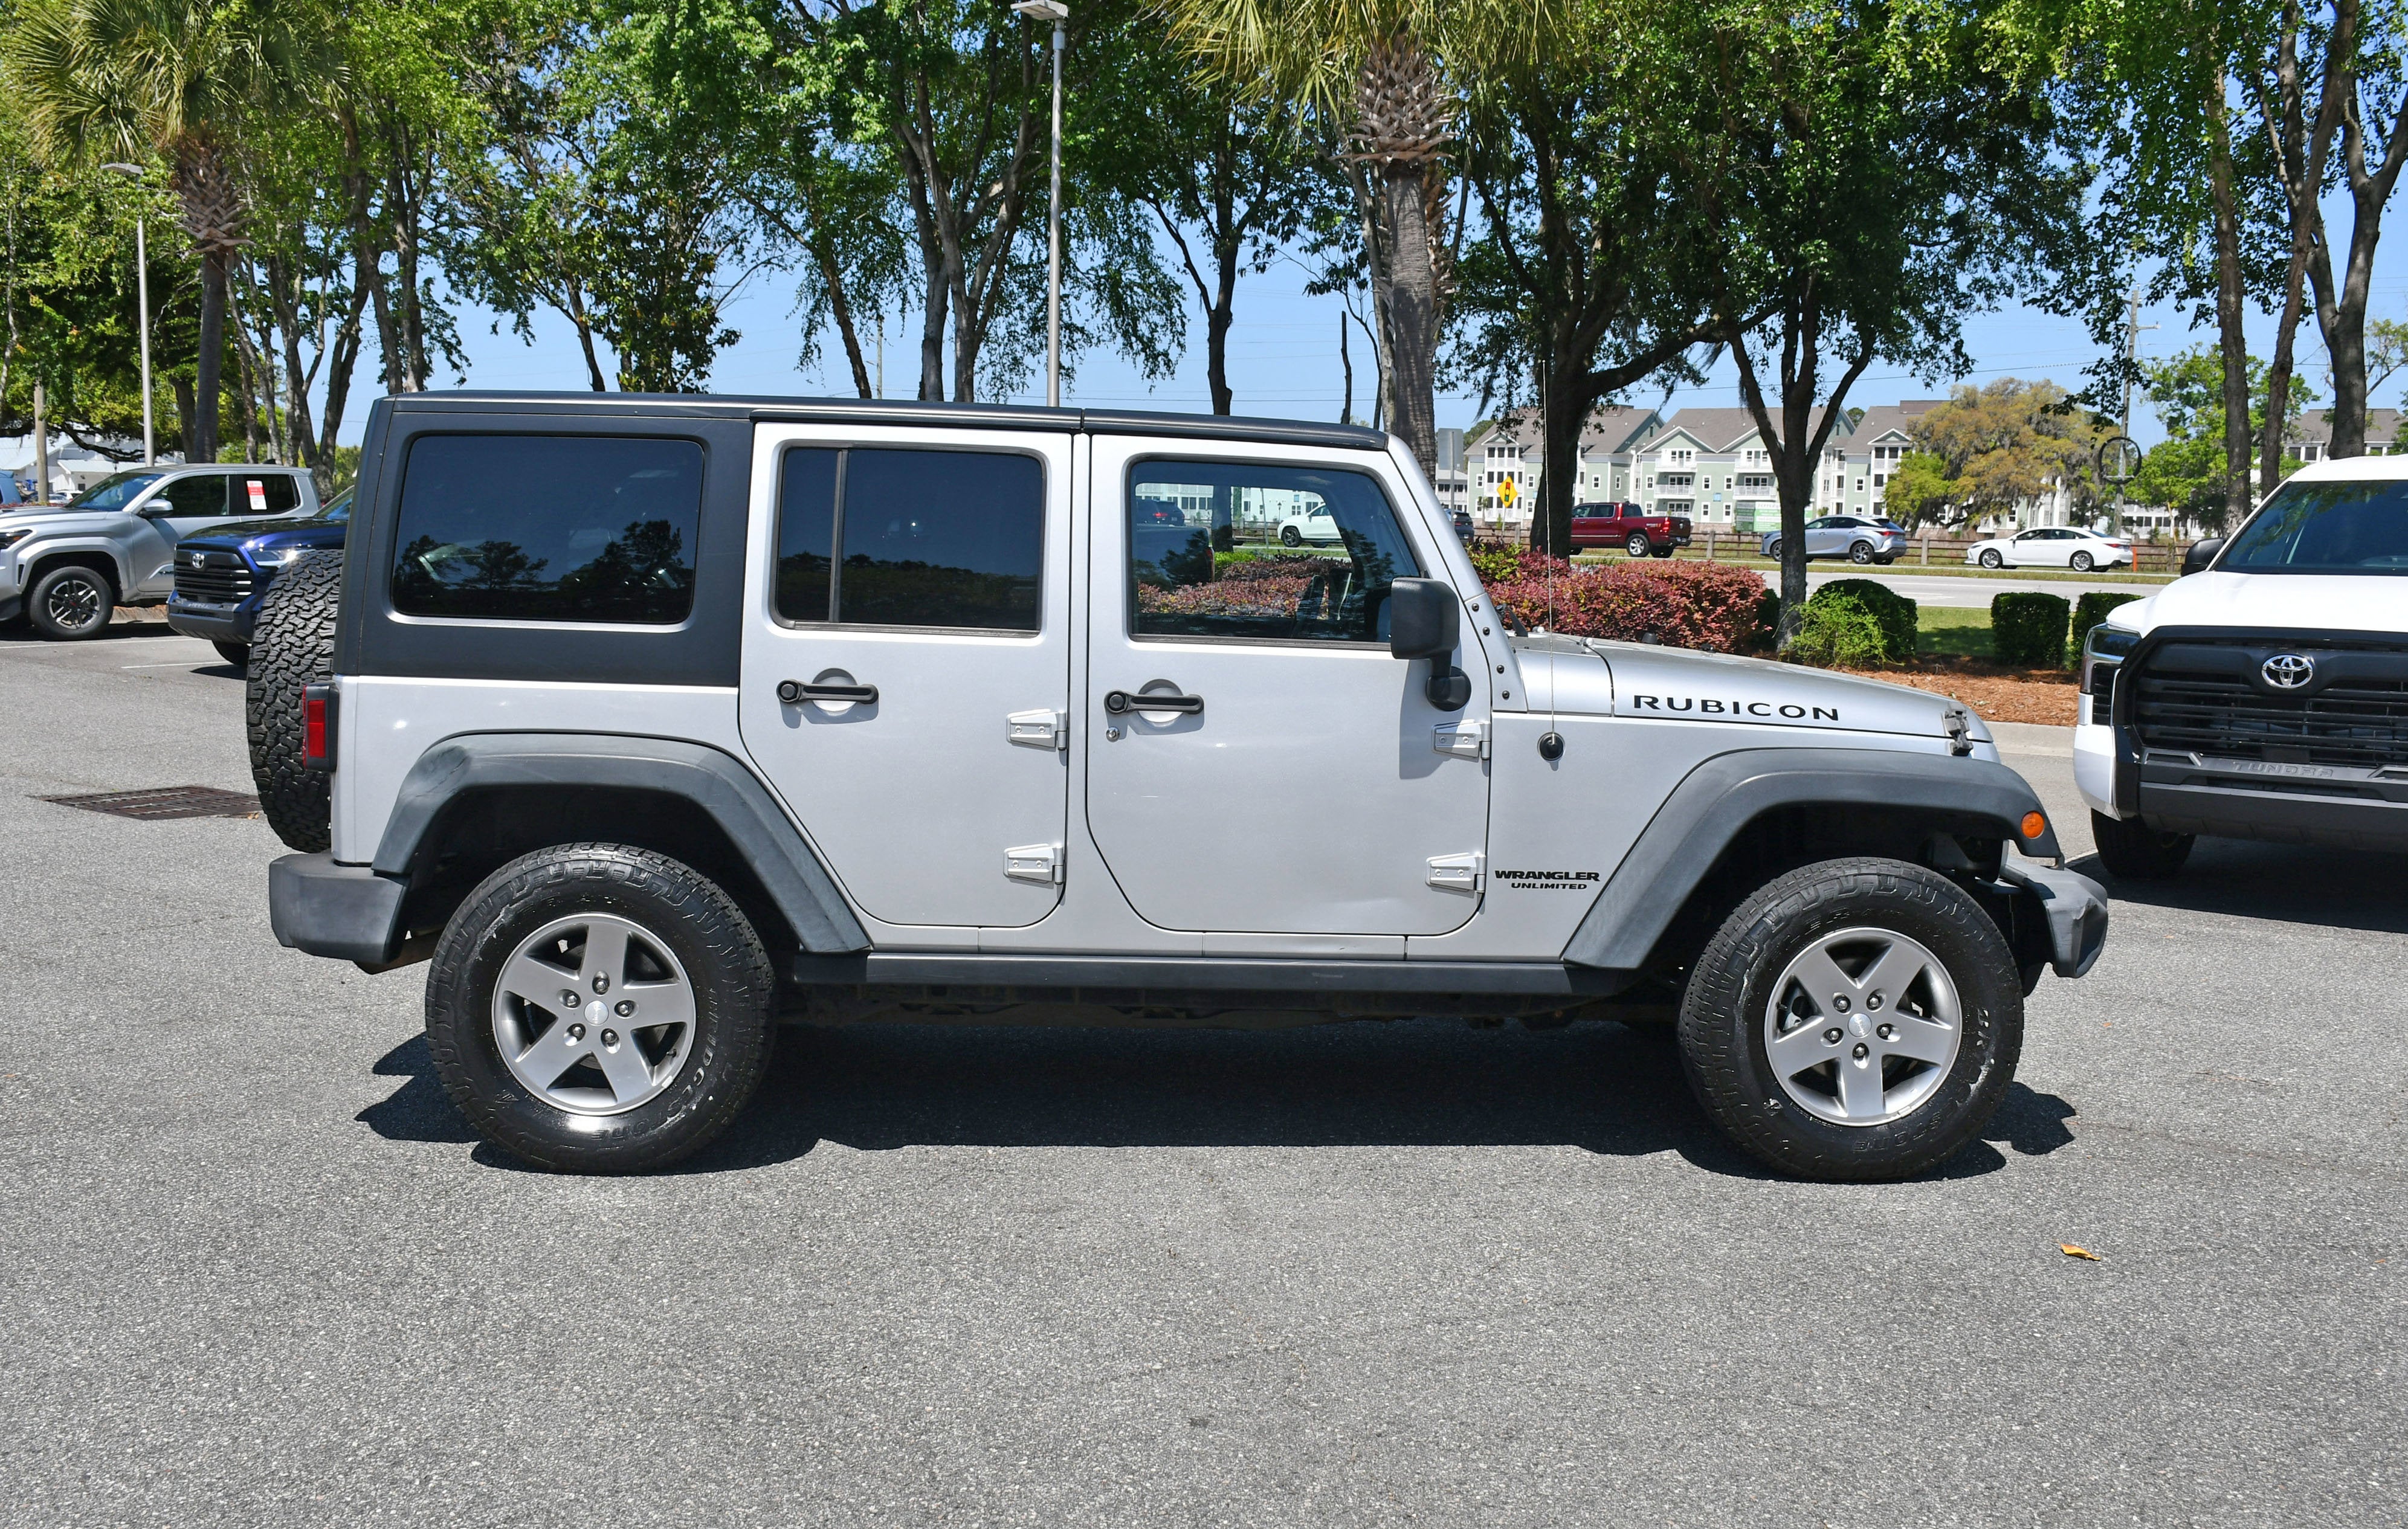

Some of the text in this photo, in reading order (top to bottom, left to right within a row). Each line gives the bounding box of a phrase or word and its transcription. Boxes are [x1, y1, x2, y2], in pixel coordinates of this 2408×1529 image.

[1633, 695, 1839, 721] RUBICON
[2233, 761, 2334, 777] TUNDRA
[1494, 870, 1601, 882] WRANGLER
